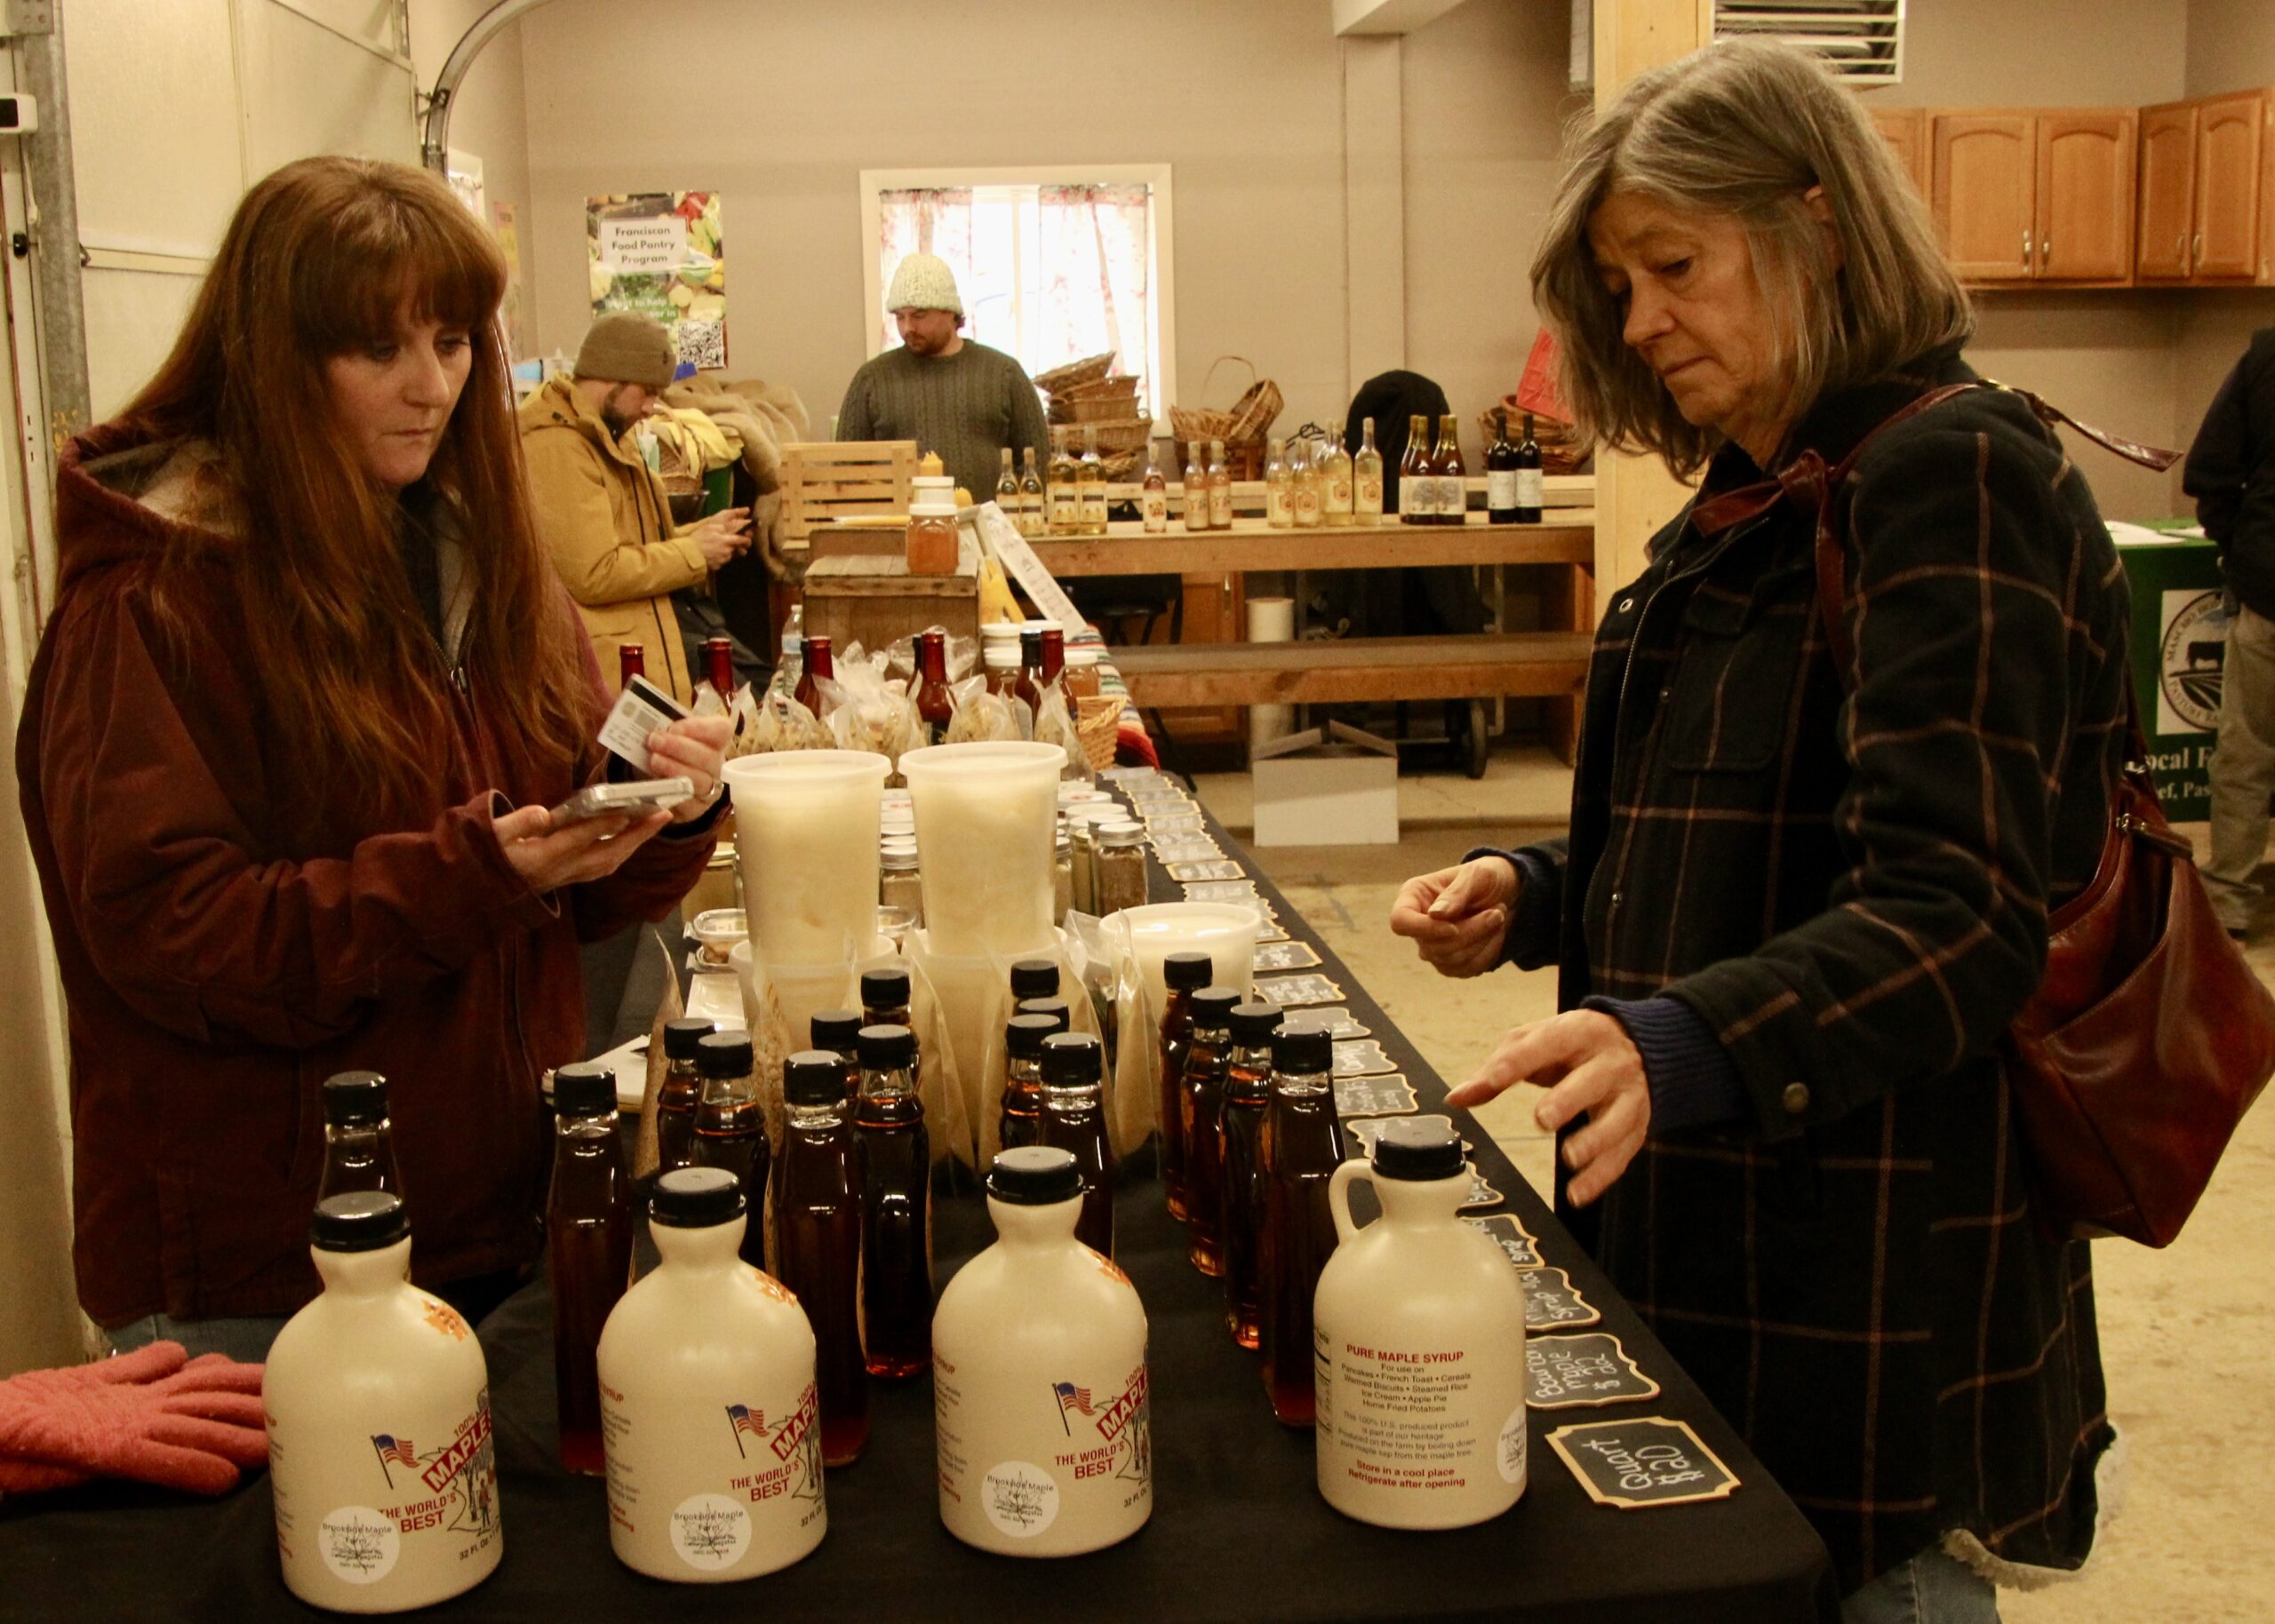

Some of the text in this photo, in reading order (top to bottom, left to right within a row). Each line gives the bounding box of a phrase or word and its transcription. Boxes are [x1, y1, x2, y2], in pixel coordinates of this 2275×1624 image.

[615, 226, 671, 237] Franciscan
[611, 239, 675, 251] Food Pantry
[621, 254, 668, 266] Program
[2144, 747, 2190, 772] ocal
[1346, 1343, 1465, 1365] PURE MAPLE SYRUP
[1341, 1363, 1374, 1378] Pancakes
[1381, 1373, 1409, 1382] French
[1441, 1373, 1472, 1382] Cereals
[1380, 1363, 1394, 1373] For
[1343, 1373, 1469, 1393] Warmed Biscuits Steamed Rice
[1361, 1389, 1448, 1405] Ice Cream Apple Pie
[1362, 1398, 1447, 1413] Home Fried Potatoes
[452, 1411, 476, 1438] 100%
[1440, 1419, 1470, 1431] product
[1410, 1431, 1444, 1442] heritage
[427, 1413, 491, 1493] MAPLE
[1055, 1440, 1125, 1468] THE WORLD'S
[1074, 1457, 1115, 1480] BEST
[1356, 1459, 1380, 1475] Store
[1383, 1466, 1392, 1476] in
[1402, 1468, 1425, 1477] cool
[1427, 1467, 1455, 1478] place
[1581, 1438, 1653, 1491] Quart
[730, 1461, 800, 1491] THE WORLD'S
[1347, 1468, 1465, 1490] Refrigerate after opening
[750, 1477, 791, 1503] BEST
[1008, 1490, 1029, 1500] Farm
[1028, 1482, 1055, 1493] Maple
[404, 1493, 458, 1516] WORLD'S
[1123, 1498, 1133, 1509] 32
[400, 1509, 446, 1533] BEST
[717, 1510, 745, 1522] Maple
[801, 1515, 810, 1528] 32
[364, 1525, 393, 1535] Maple
[698, 1524, 721, 1532] Farm
[344, 1537, 367, 1546] Farm
[459, 1549, 469, 1561] 32
